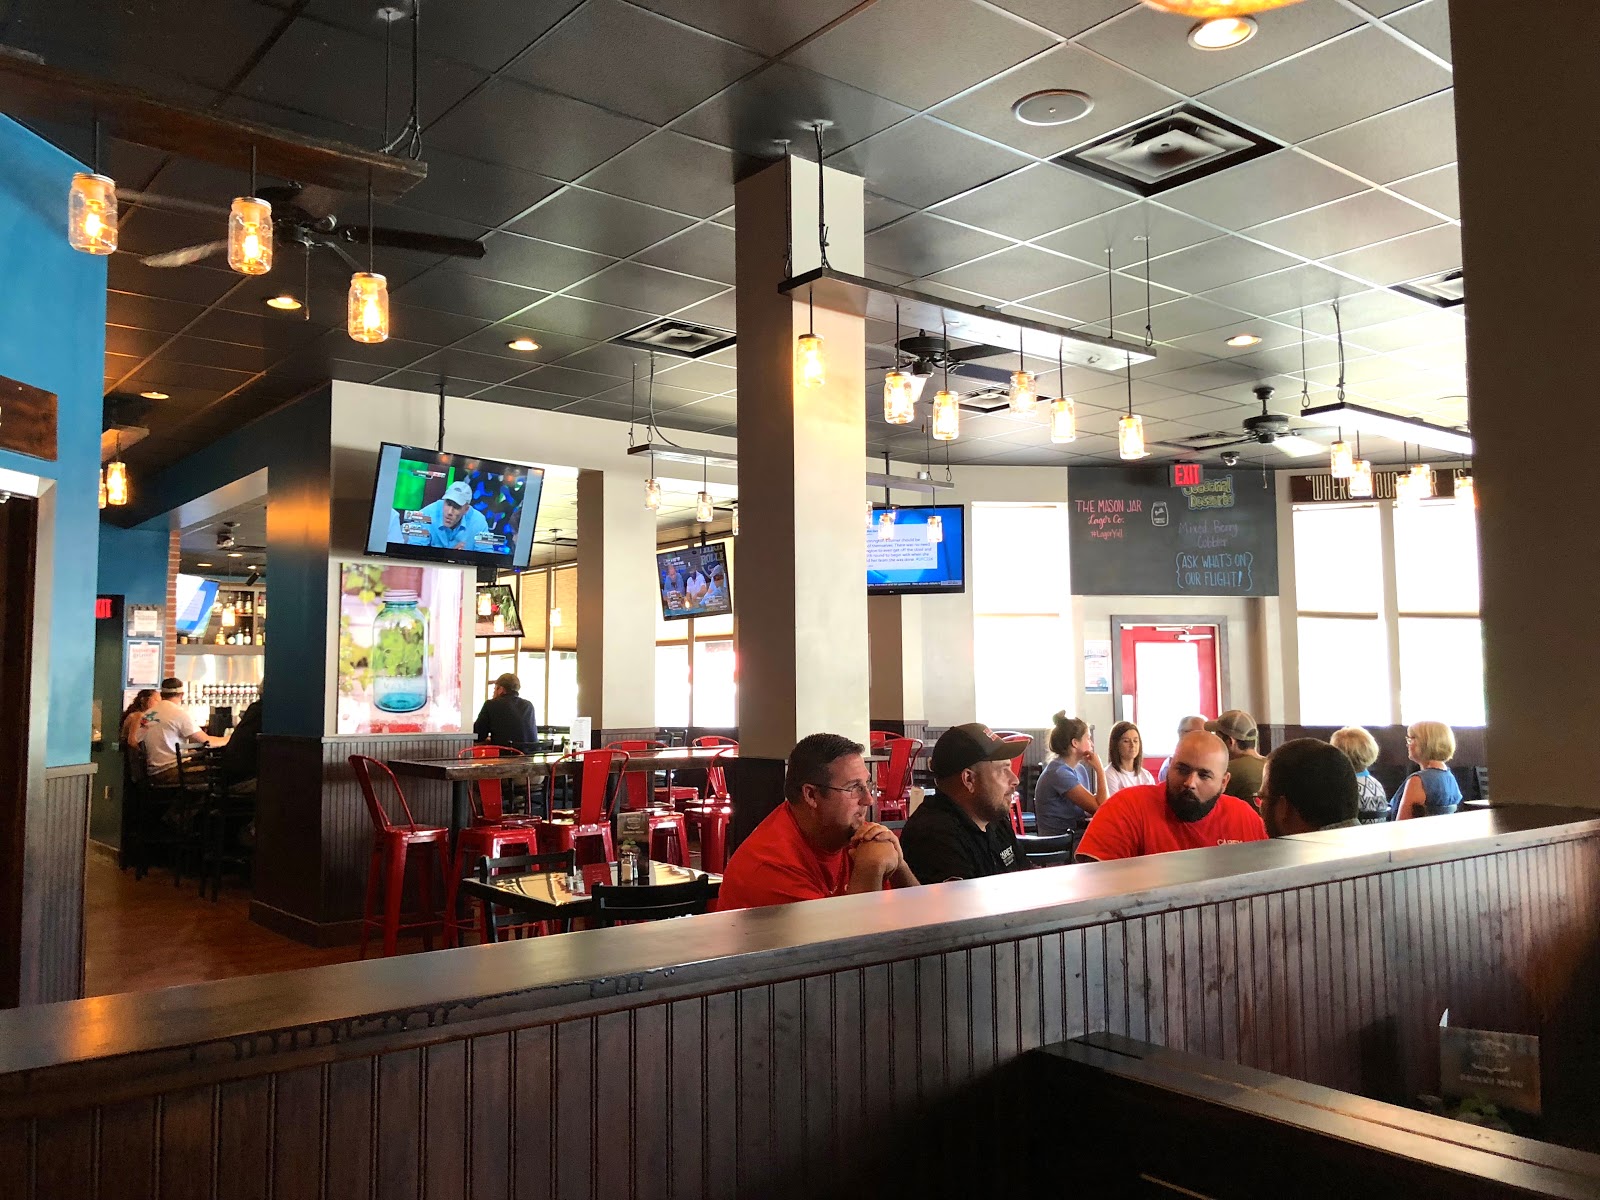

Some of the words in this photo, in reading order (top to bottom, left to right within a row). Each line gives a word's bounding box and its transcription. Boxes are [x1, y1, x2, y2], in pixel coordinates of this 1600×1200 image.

[1175, 464, 1200, 485] EXIT
[1075, 500, 1095, 513] THE
[1098, 499, 1124, 513] MASON
[1126, 499, 1142, 513] JAR
[1190, 493, 1233, 508] Desserts
[1087, 514, 1112, 530] Lager
[1112, 514, 1125, 524] Co.
[1181, 554, 1199, 569] ASK
[1201, 553, 1232, 568] WHAT'S
[1234, 553, 1247, 567] ON
[1185, 571, 1202, 586] OUR
[1204, 570, 1243, 588] FLIGHT!
[95, 599, 112, 618] XIT
[999, 845, 1014, 860] AREY
